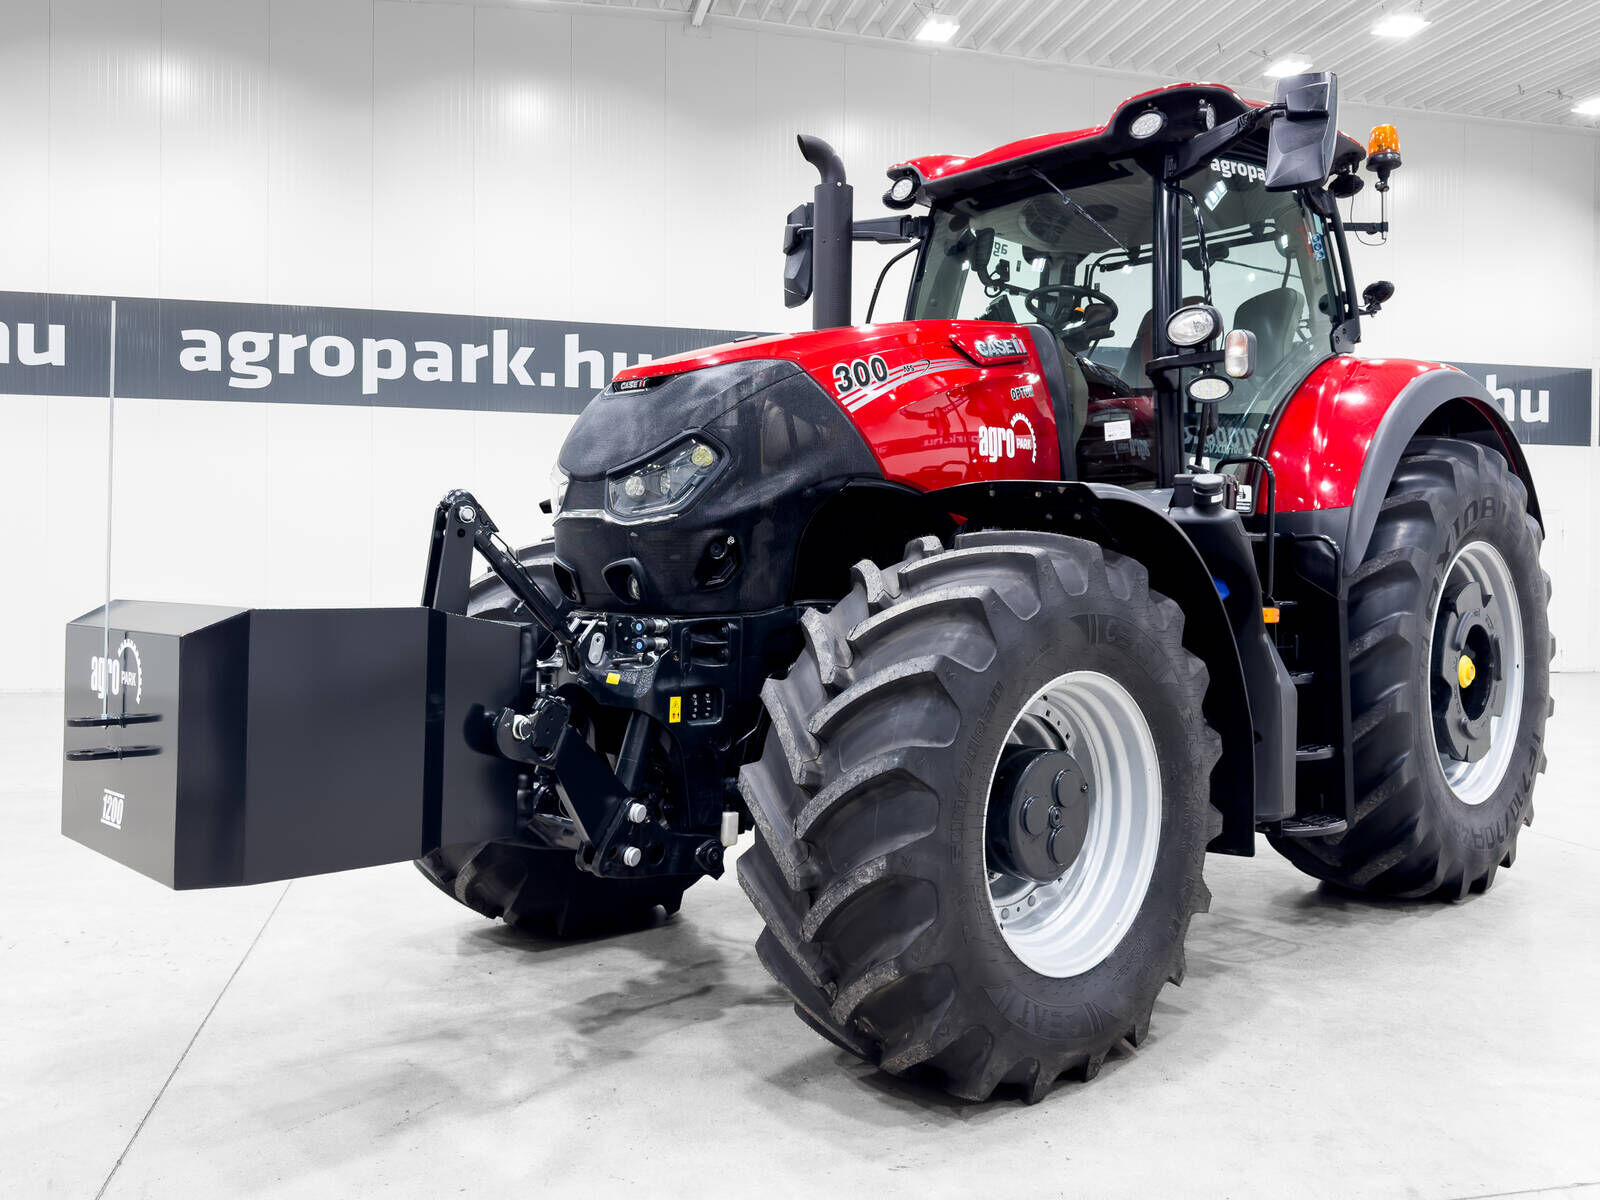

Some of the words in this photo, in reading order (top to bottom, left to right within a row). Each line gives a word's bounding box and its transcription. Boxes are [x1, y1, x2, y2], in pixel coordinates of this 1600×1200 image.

[1210, 158, 1267, 183] agropa
[975, 336, 1016, 357] CASE
[833, 355, 888, 394] 300
[978, 425, 1015, 463] agro
[1016, 436, 1032, 451] PARK
[91, 656, 121, 699] agro
[121, 670, 136, 687] PARK
[103, 793, 124, 826] 1200
